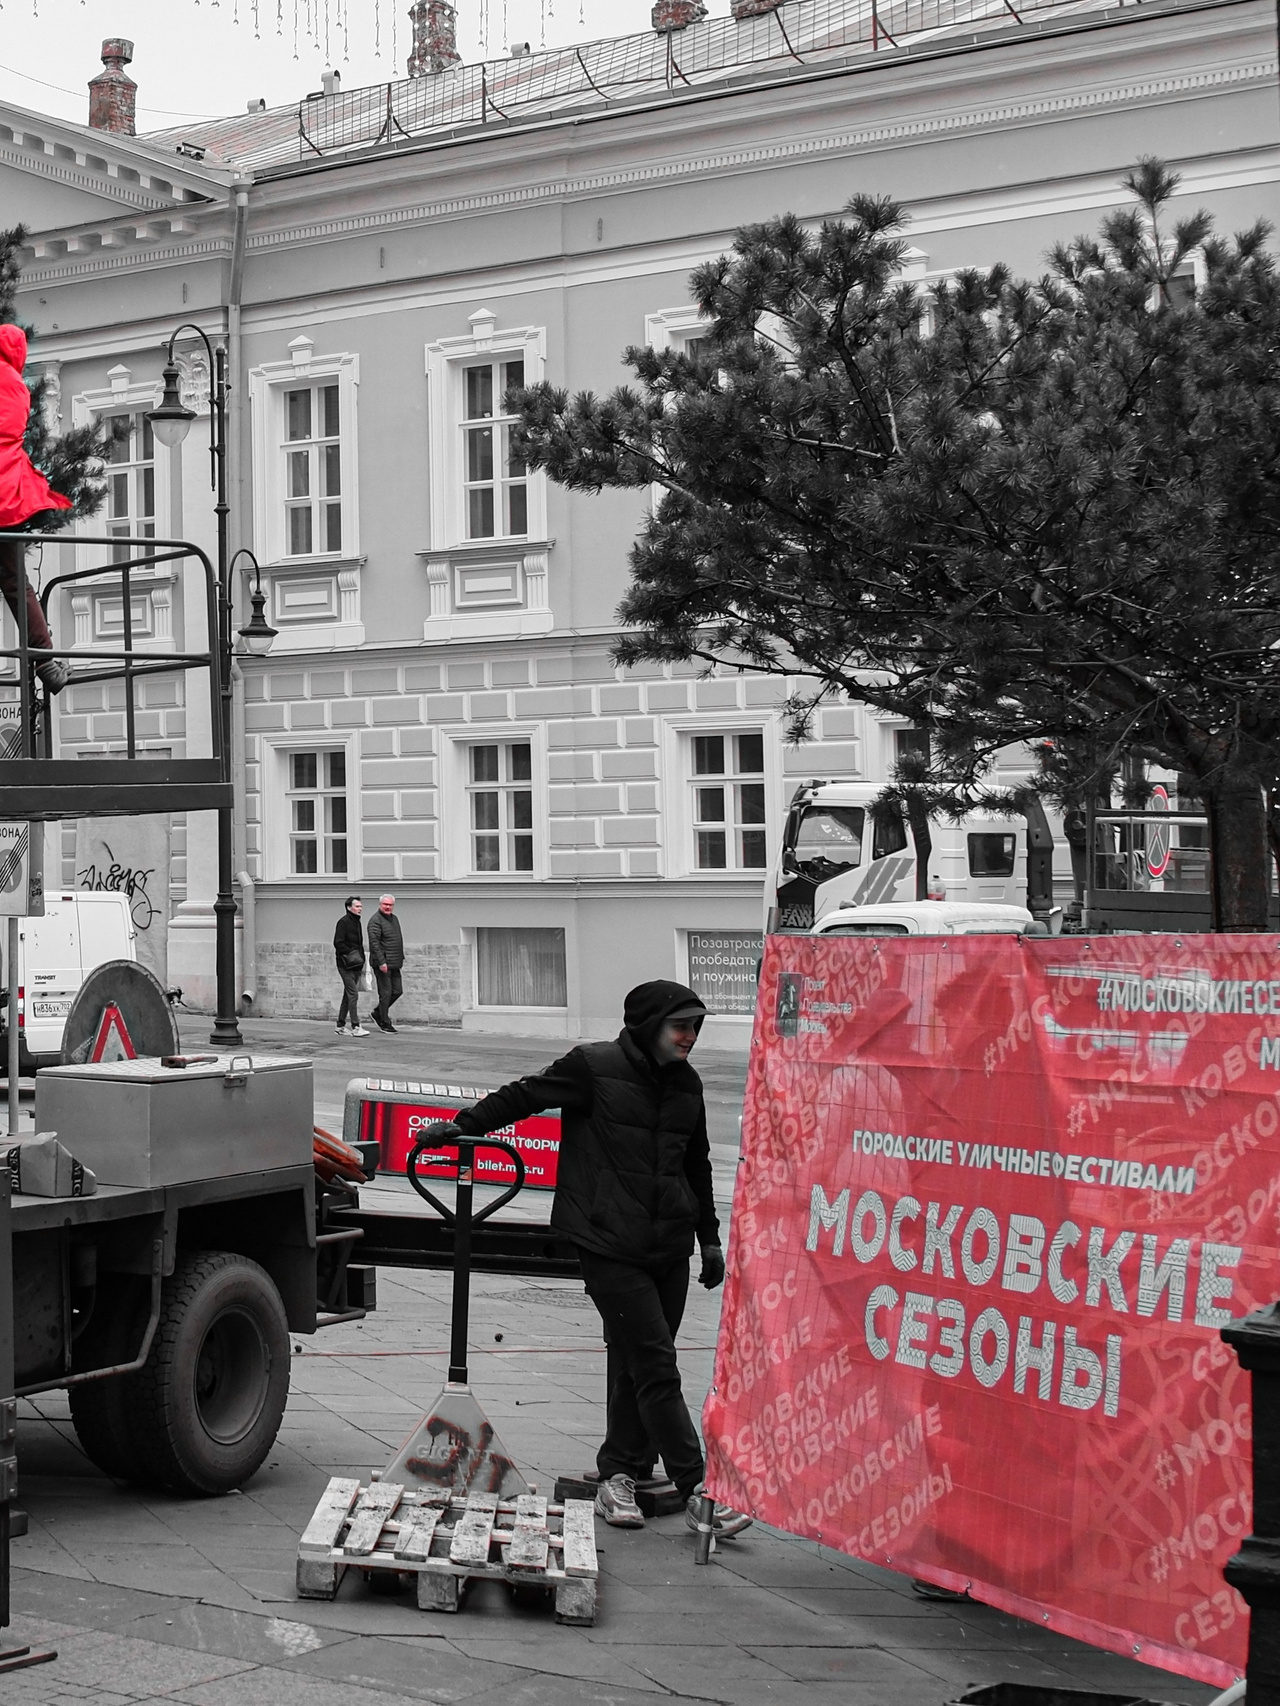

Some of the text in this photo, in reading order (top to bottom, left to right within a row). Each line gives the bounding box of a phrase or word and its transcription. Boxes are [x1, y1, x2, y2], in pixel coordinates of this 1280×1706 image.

[780, 914, 814, 928] FAW
[692, 952, 757, 967] пообедать
[692, 972, 700, 982] и
[477, 1159, 545, 1176] bilet.ms.ru
[852, 1129, 1196, 1196] ГОРОДСКИЕ УЛИЧНЫЕ ФЕСТИВАЛИ
[805, 1183, 1243, 1329] МОСКОВСКИЕ
[864, 1283, 1123, 1419] СЕЗОНЫ
[415, 1444, 496, 1464] GIGNT
